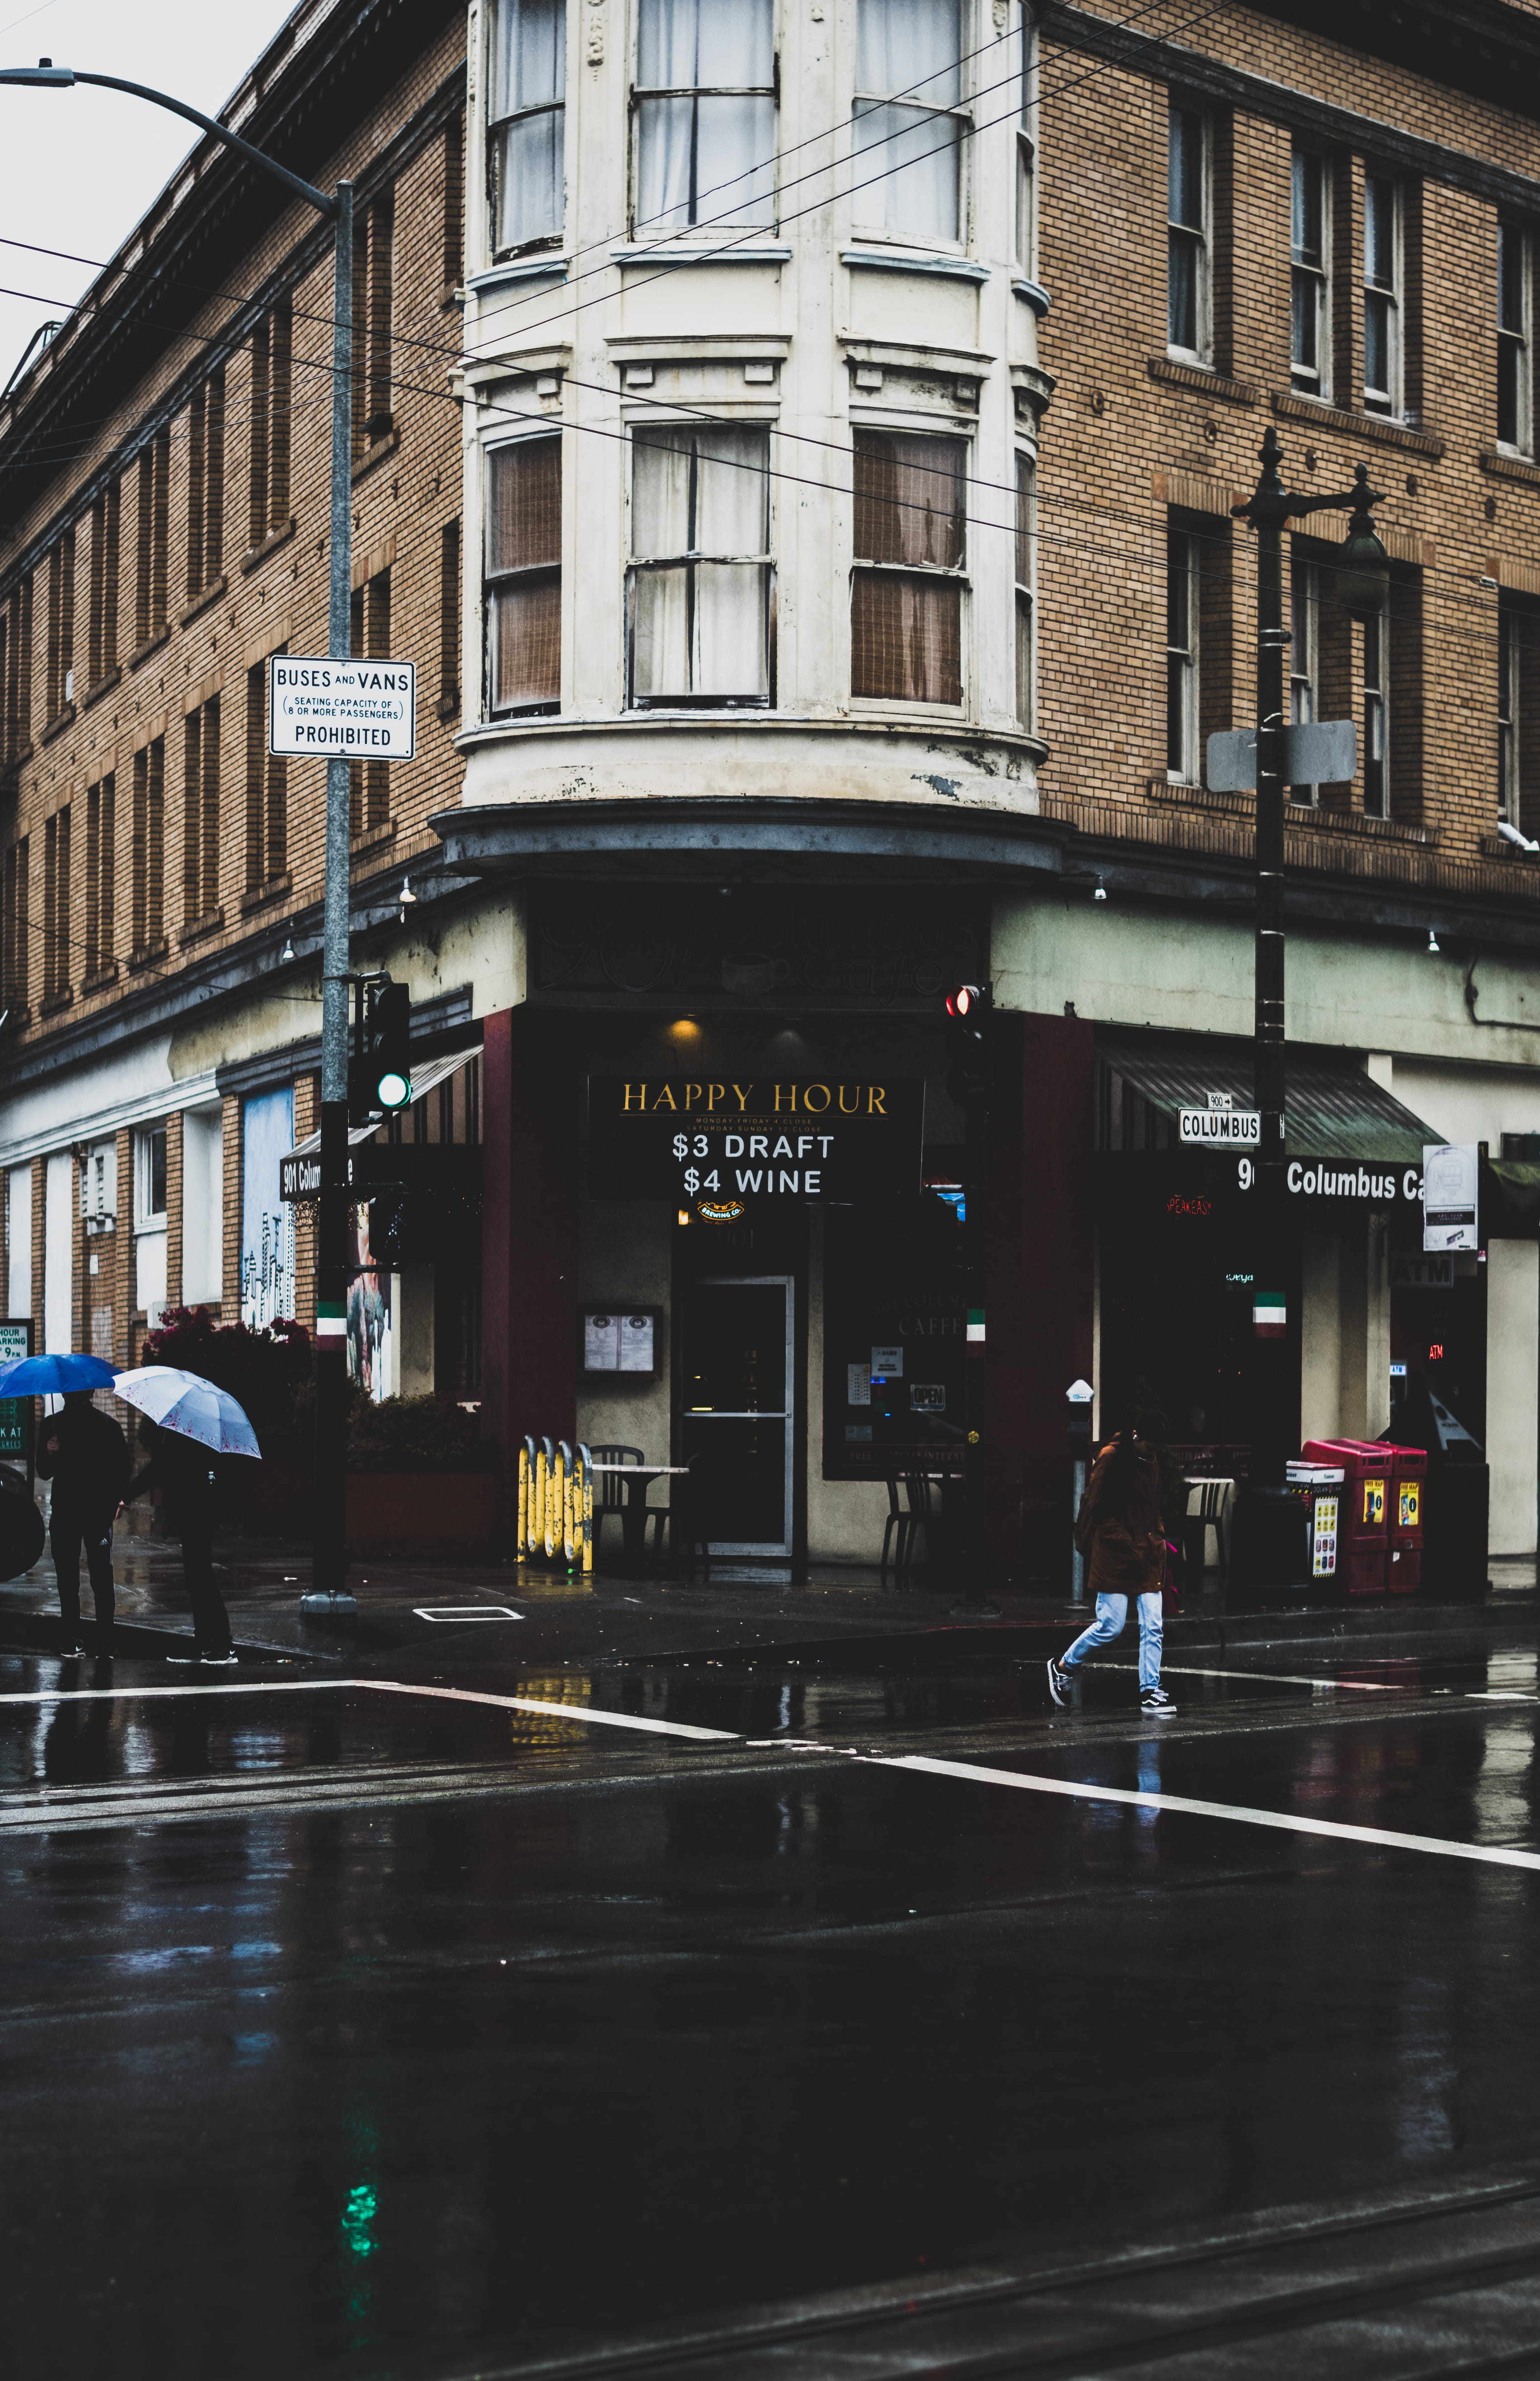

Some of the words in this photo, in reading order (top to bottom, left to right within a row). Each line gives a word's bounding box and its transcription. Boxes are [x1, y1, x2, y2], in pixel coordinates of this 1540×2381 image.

[277, 669, 331, 687] BUSES
[335, 676, 355, 684] AND
[357, 673, 408, 691] VANS
[295, 697, 331, 706] SEATING
[334, 699, 378, 708] CAPACITY
[340, 709, 398, 719] PASSENGERS
[296, 726, 390, 746] PROHIBITED
[622, 1084, 755, 1112] HAPPY
[774, 1084, 888, 1114] HOUR
[1211, 1096, 1222, 1107] 900
[1183, 1115, 1257, 1138] COLUMBUS
[672, 1133, 708, 1162] $3
[725, 1136, 834, 1159] DRAFT
[284, 1162, 297, 1194] 901
[299, 1160, 321, 1191] Colum
[684, 1166, 721, 1197] $4
[736, 1169, 821, 1193] WINE
[1287, 1162, 1395, 1199] Columbus
[702, 1207, 731, 1218] BREWING
[1392, 1259, 1450, 1282] ATM
[5, 1347, 11, 1357] 9
[1429, 1344, 1444, 1359] ATM
[914, 1387, 943, 1404] OPEN
[10, 1427, 22, 1437] AT
